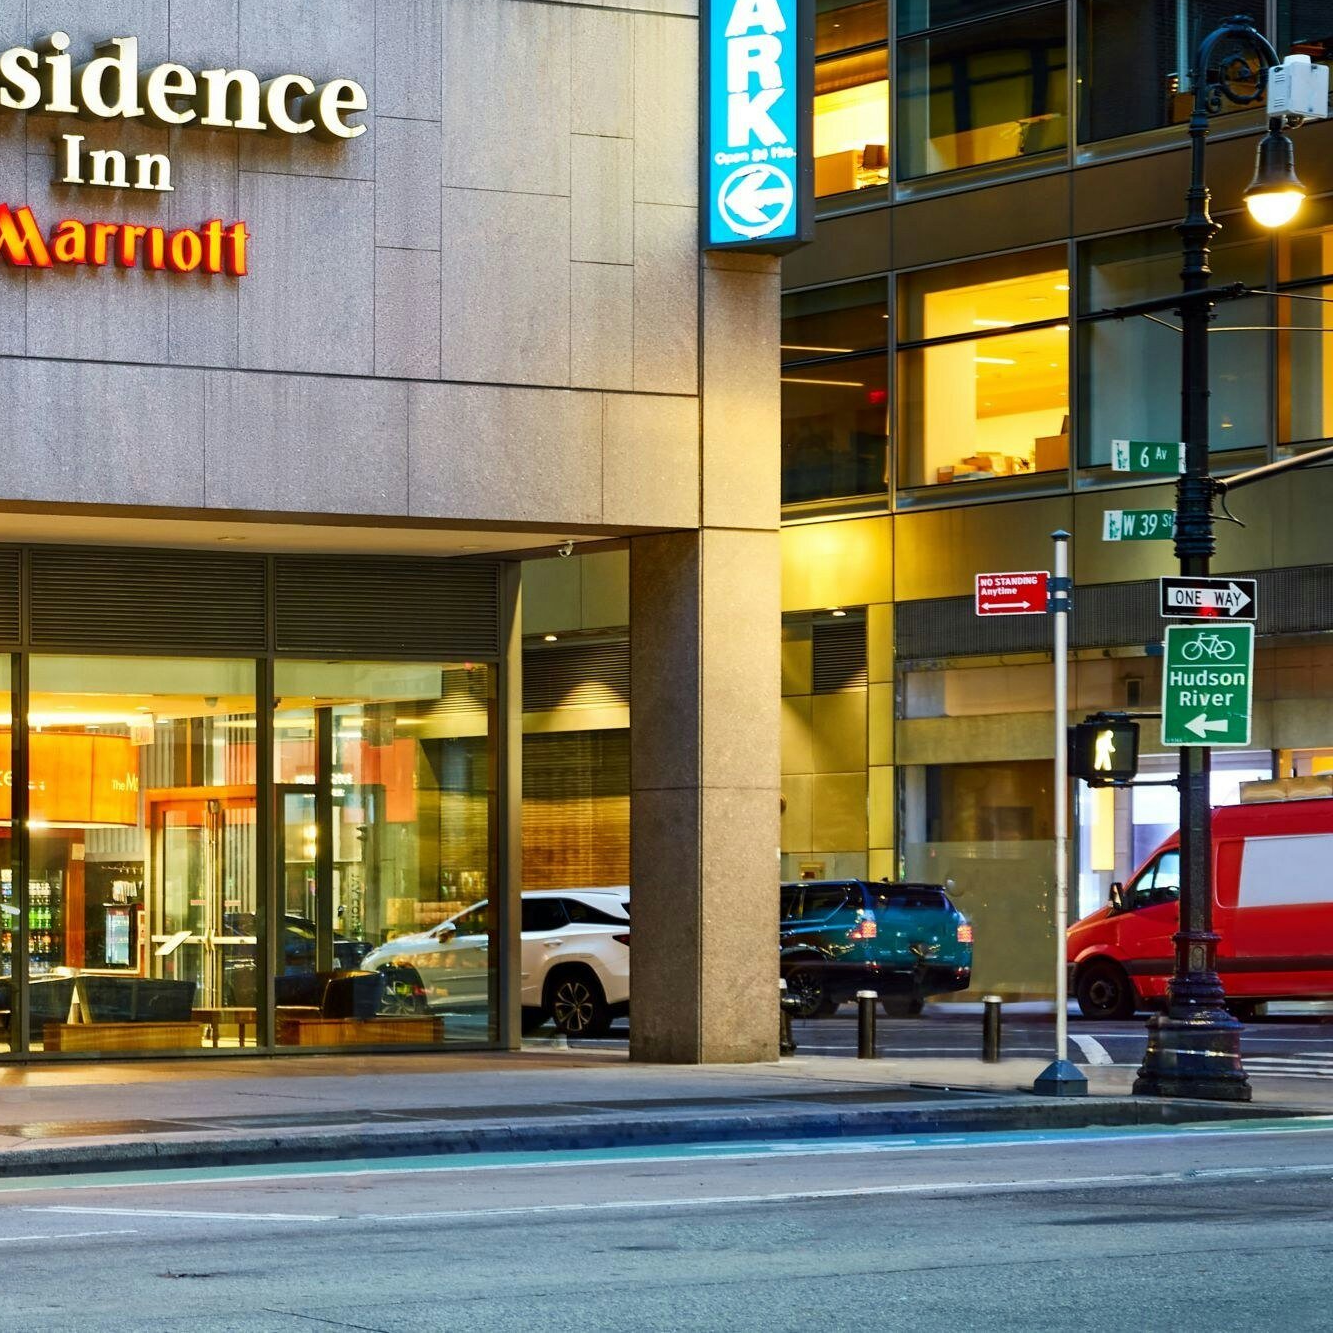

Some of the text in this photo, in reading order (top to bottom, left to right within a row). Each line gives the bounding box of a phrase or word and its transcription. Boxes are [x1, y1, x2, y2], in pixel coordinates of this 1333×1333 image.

[58, 133, 175, 192] Inn
[1140, 446, 1167, 468] 6 Av
[1123, 513, 1173, 537] W 39 St
[980, 576, 1038, 587] NO STANDING
[980, 587, 1018, 597] Anytime
[1175, 589, 1242, 606] ONE WAY
[1169, 669, 1246, 687] Hudson
[1179, 691, 1234, 707] River
